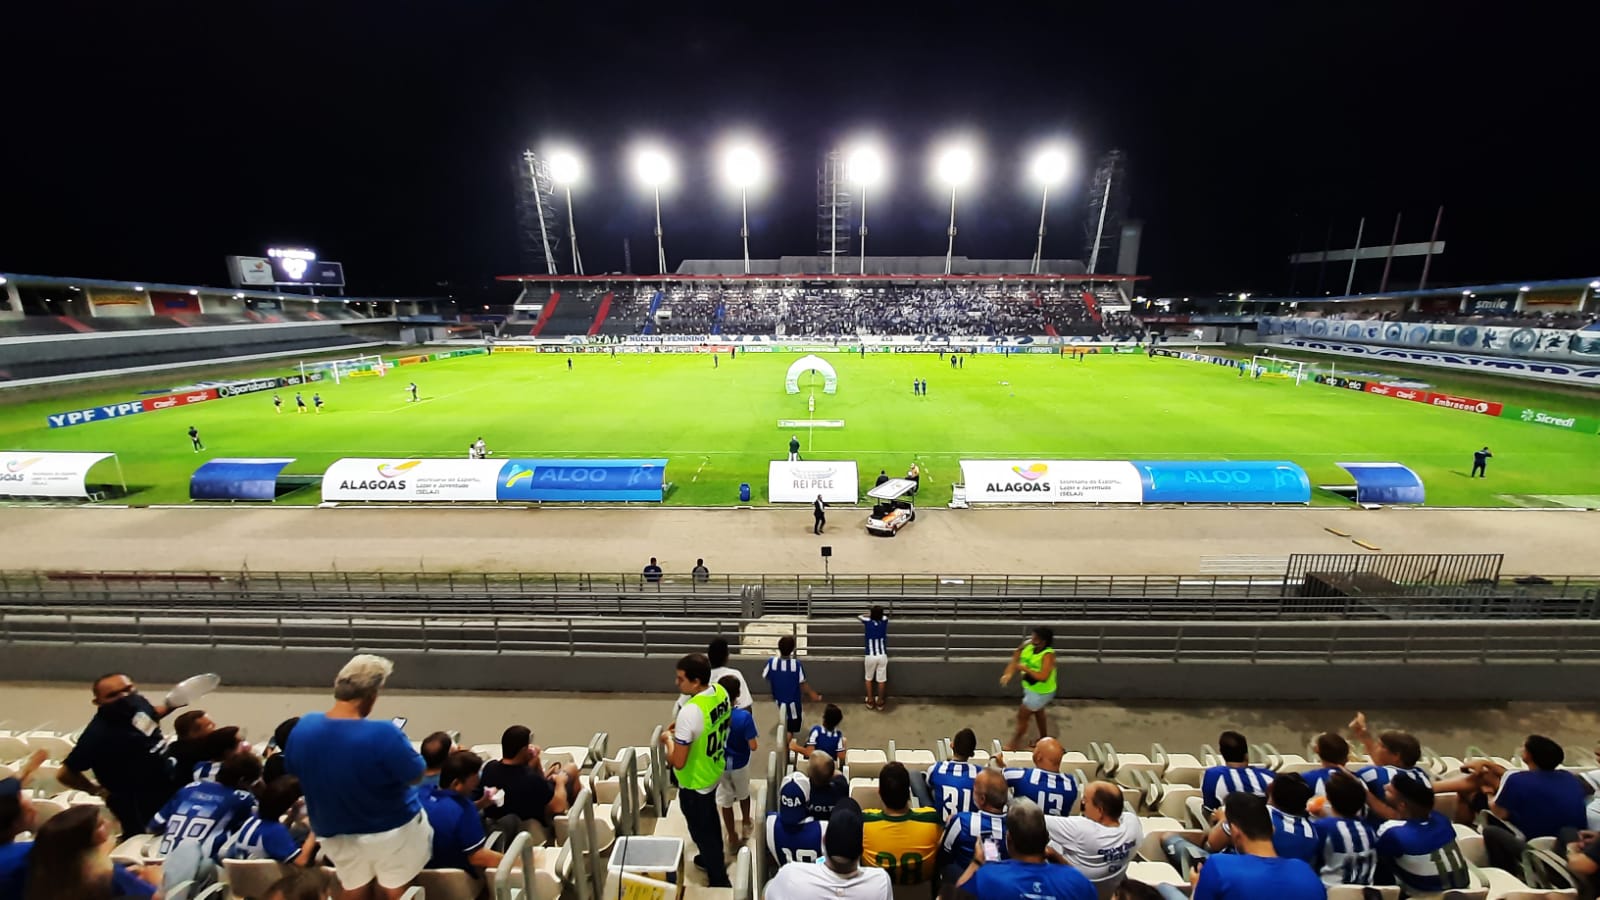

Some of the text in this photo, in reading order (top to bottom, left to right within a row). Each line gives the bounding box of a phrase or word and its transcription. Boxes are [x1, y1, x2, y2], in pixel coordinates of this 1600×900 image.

[1475, 298, 1508, 309] smile
[229, 379, 276, 395] Sportsbet.io
[103, 401, 144, 417] YPF
[1433, 397, 1475, 411] Embracon
[50, 409, 95, 427] YPF
[1535, 413, 1575, 428] Sicredi
[540, 468, 607, 482] ALOO
[1184, 470, 1250, 484] ALOO
[339, 480, 406, 490] ALAGOAS
[793, 480, 808, 489] REI
[986, 482, 1050, 492] ALAGOAS
[781, 795, 802, 807] CSA
[942, 784, 971, 822] 31
